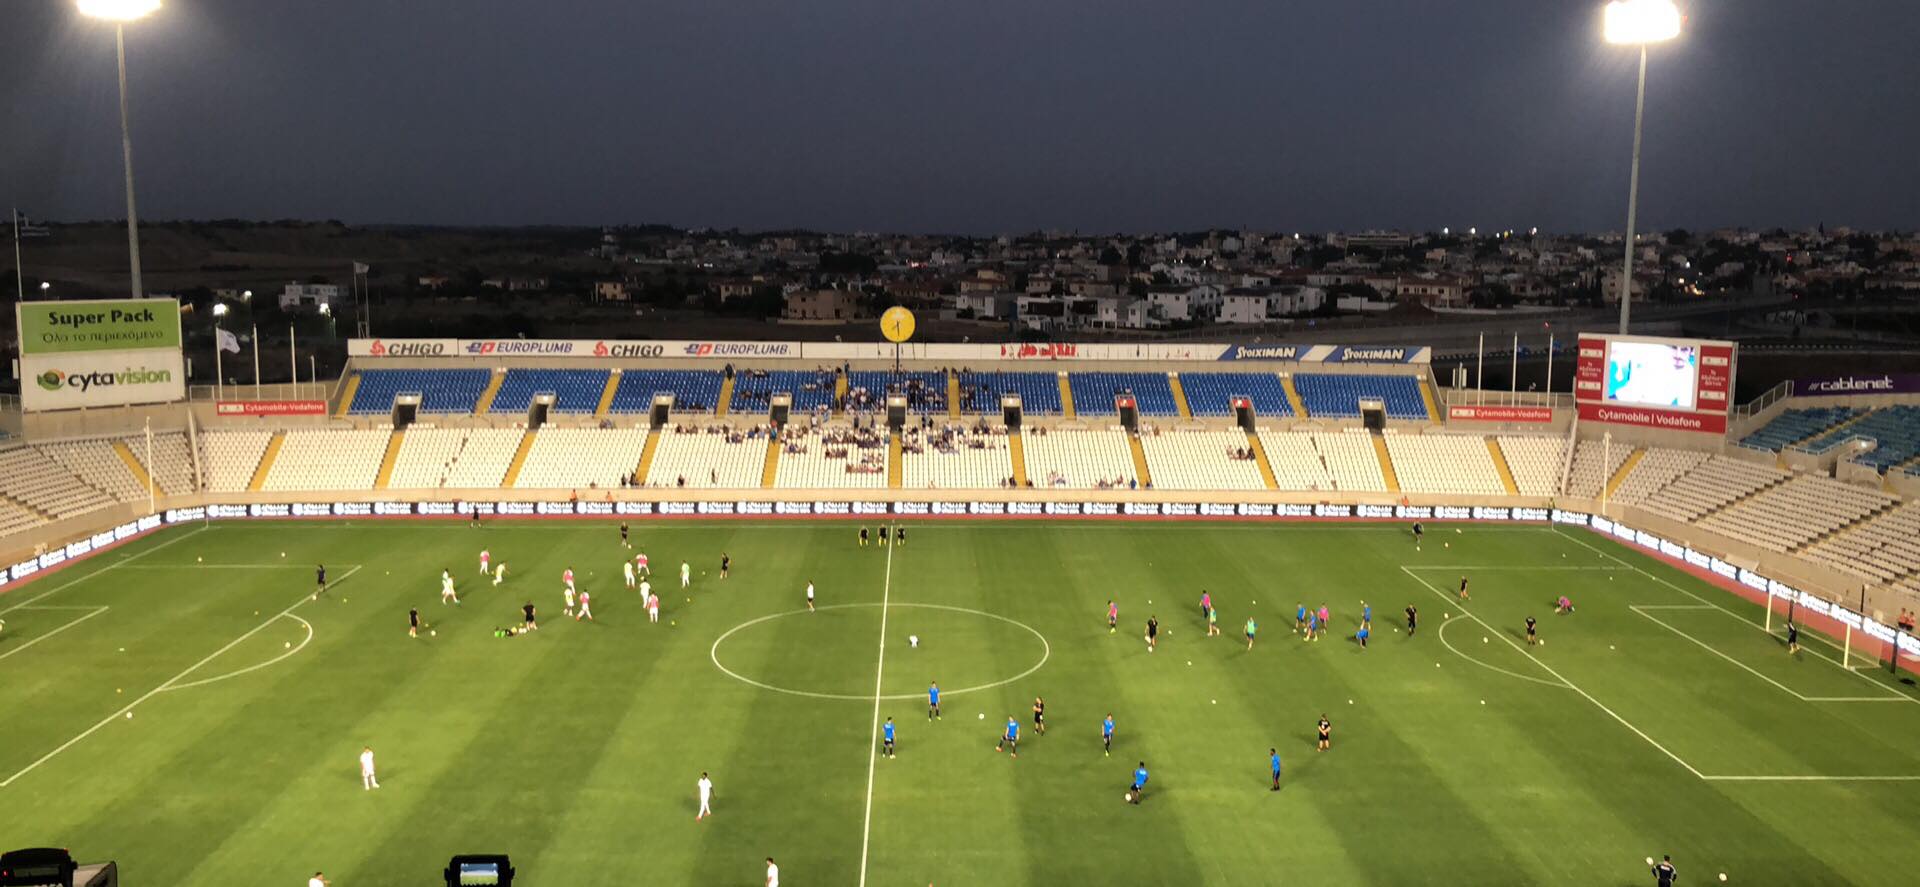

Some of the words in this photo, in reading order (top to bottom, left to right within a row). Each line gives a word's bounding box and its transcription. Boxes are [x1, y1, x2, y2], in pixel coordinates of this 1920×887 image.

[49, 311, 105, 328] Super
[111, 309, 154, 323] Pack
[388, 343, 444, 356] CHIGO
[497, 342, 573, 353] EUROPLUMB
[611, 344, 664, 357] CHIGO
[714, 343, 788, 355] EUROPLUMB
[68, 366, 171, 392] cytavision
[1820, 375, 1893, 391] cablenet
[1598, 408, 1650, 423] Cytamobile
[1656, 415, 1701, 428] Vodafone
